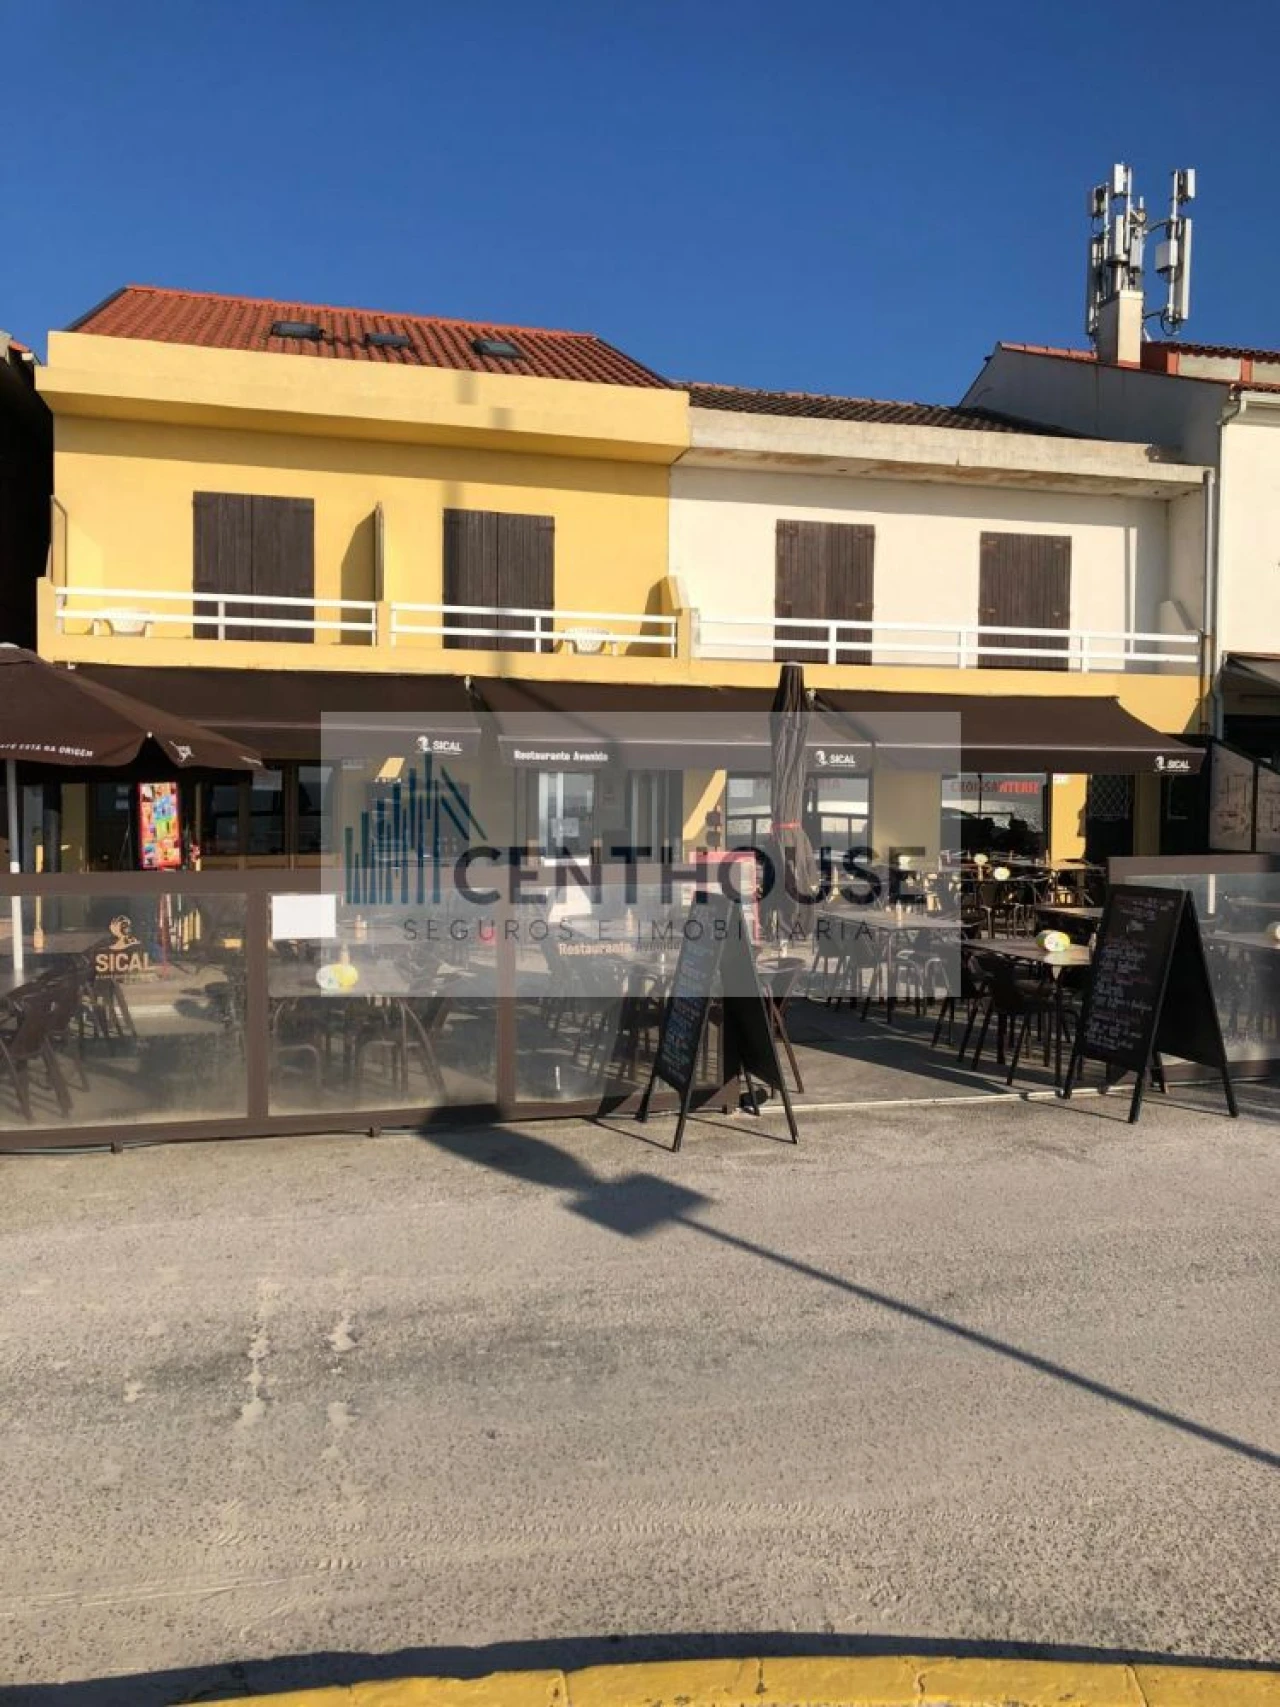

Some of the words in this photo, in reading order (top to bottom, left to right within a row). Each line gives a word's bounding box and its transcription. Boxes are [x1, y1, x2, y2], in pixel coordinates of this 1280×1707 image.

[432, 740, 463, 751] SICAL
[58, 746, 93, 757] ORIGEM
[513, 749, 570, 761] Restaurante
[572, 750, 609, 761] Avenida
[830, 754, 856, 764] SICAL
[95, 953, 155, 972] SICAL
